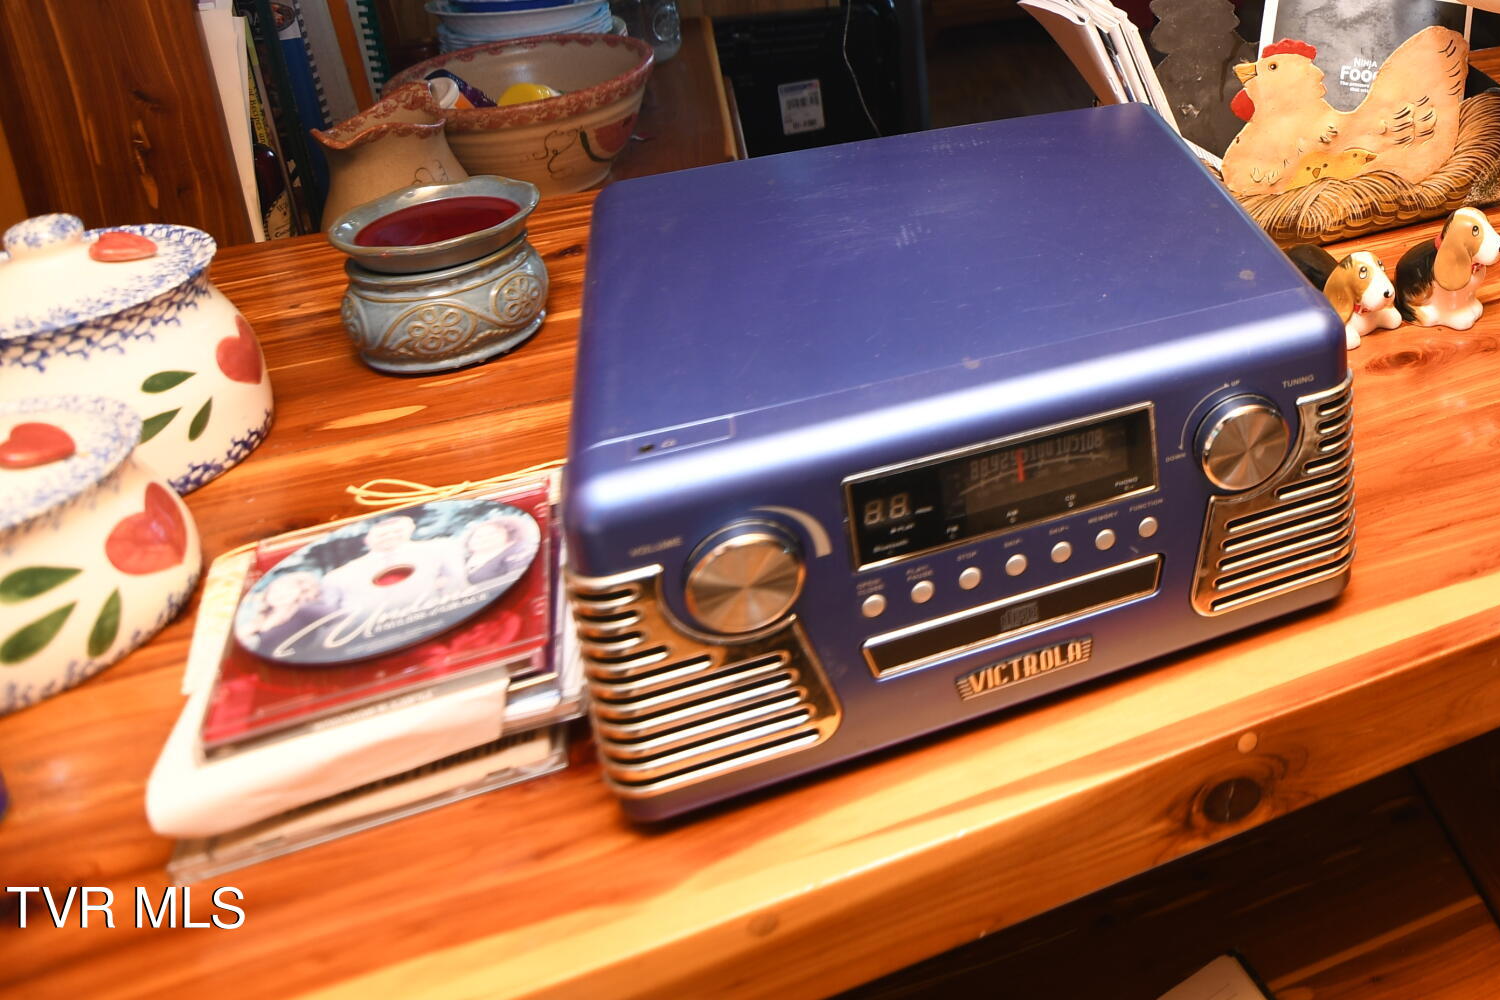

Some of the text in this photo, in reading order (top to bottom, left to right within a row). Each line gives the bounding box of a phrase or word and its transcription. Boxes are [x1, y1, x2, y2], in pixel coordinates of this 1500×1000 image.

[1353, 57, 1377, 69] NINJA
[1282, 374, 1315, 389] TUNING
[1165, 452, 1187, 463] DOWN
[1129, 498, 1164, 512] FUNCTION
[1087, 511, 1119, 524] MEMORY
[968, 641, 1082, 693] VICTROLA
